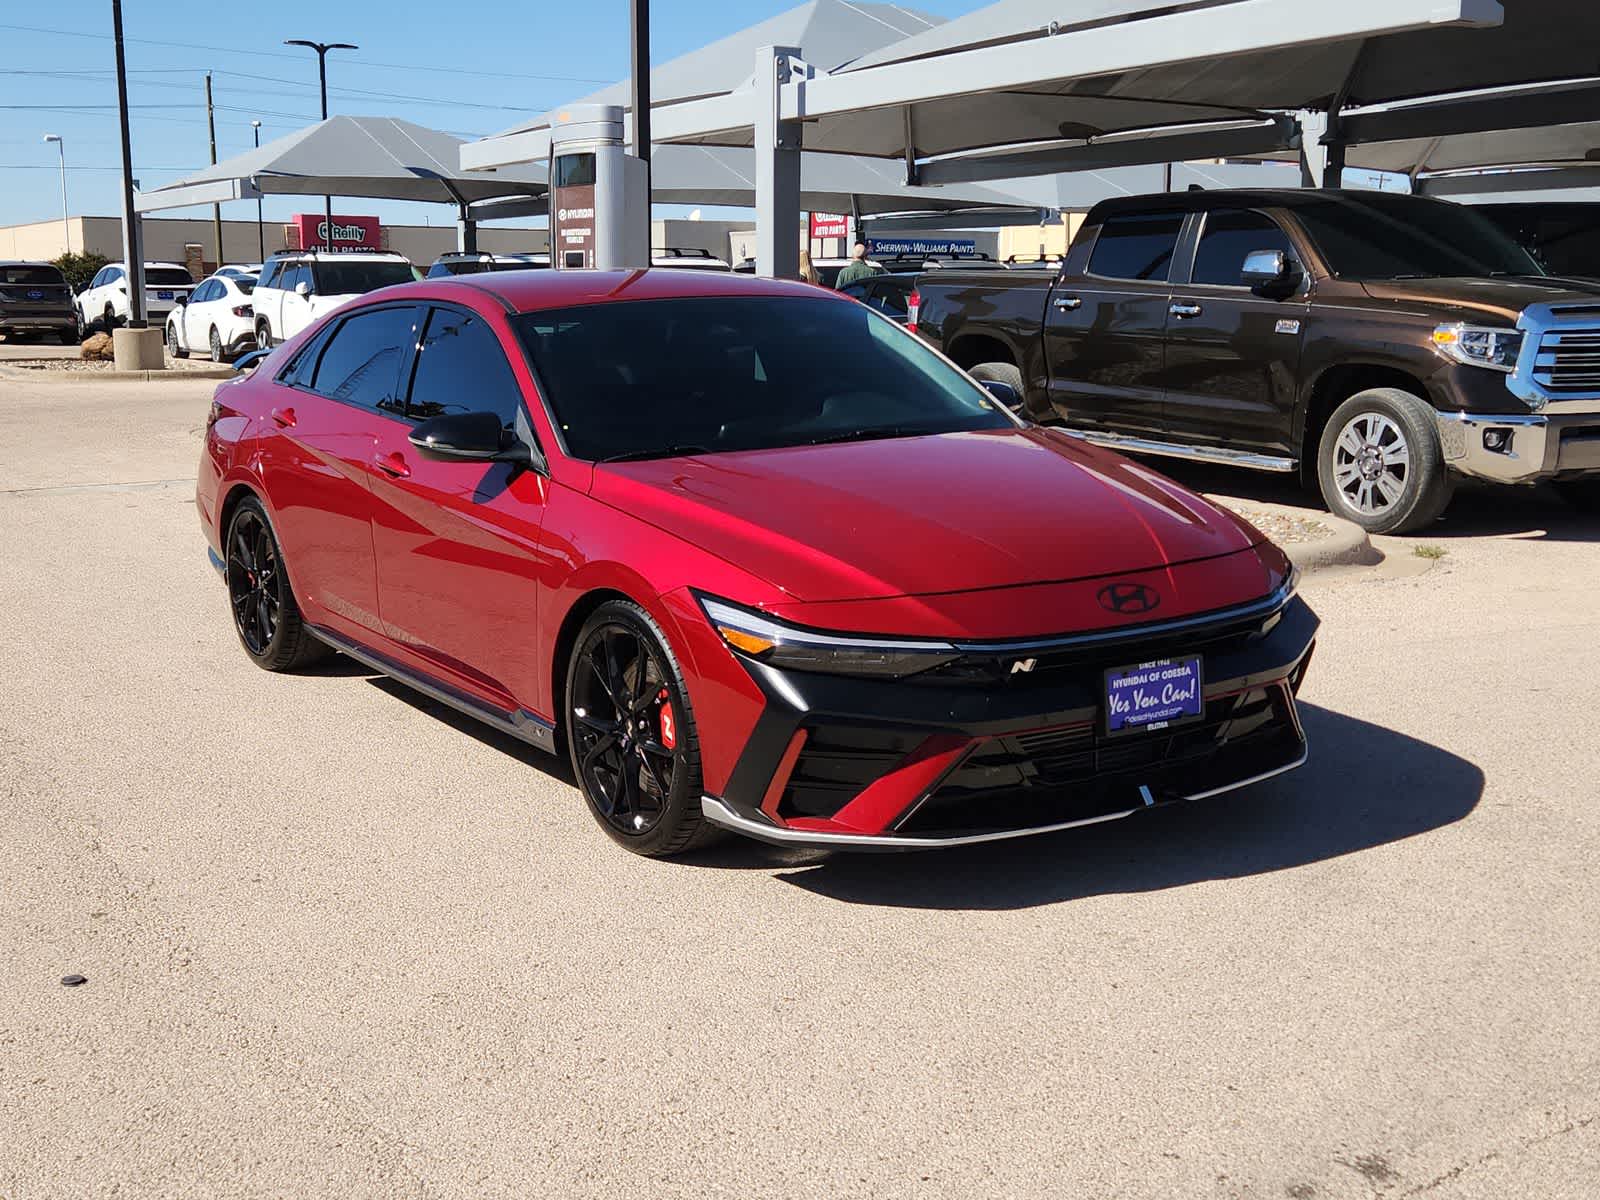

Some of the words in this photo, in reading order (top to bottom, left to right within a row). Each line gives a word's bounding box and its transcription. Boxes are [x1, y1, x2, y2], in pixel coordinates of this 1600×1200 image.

[949, 243, 975, 254] PAINTS
[1113, 674, 1148, 689] HYUNDAI
[1149, 672, 1160, 682] OF
[1161, 666, 1192, 680] ODESSA
[1109, 692, 1130, 715] Yes
[1133, 687, 1159, 710] You
[1162, 678, 1196, 705] Can!
